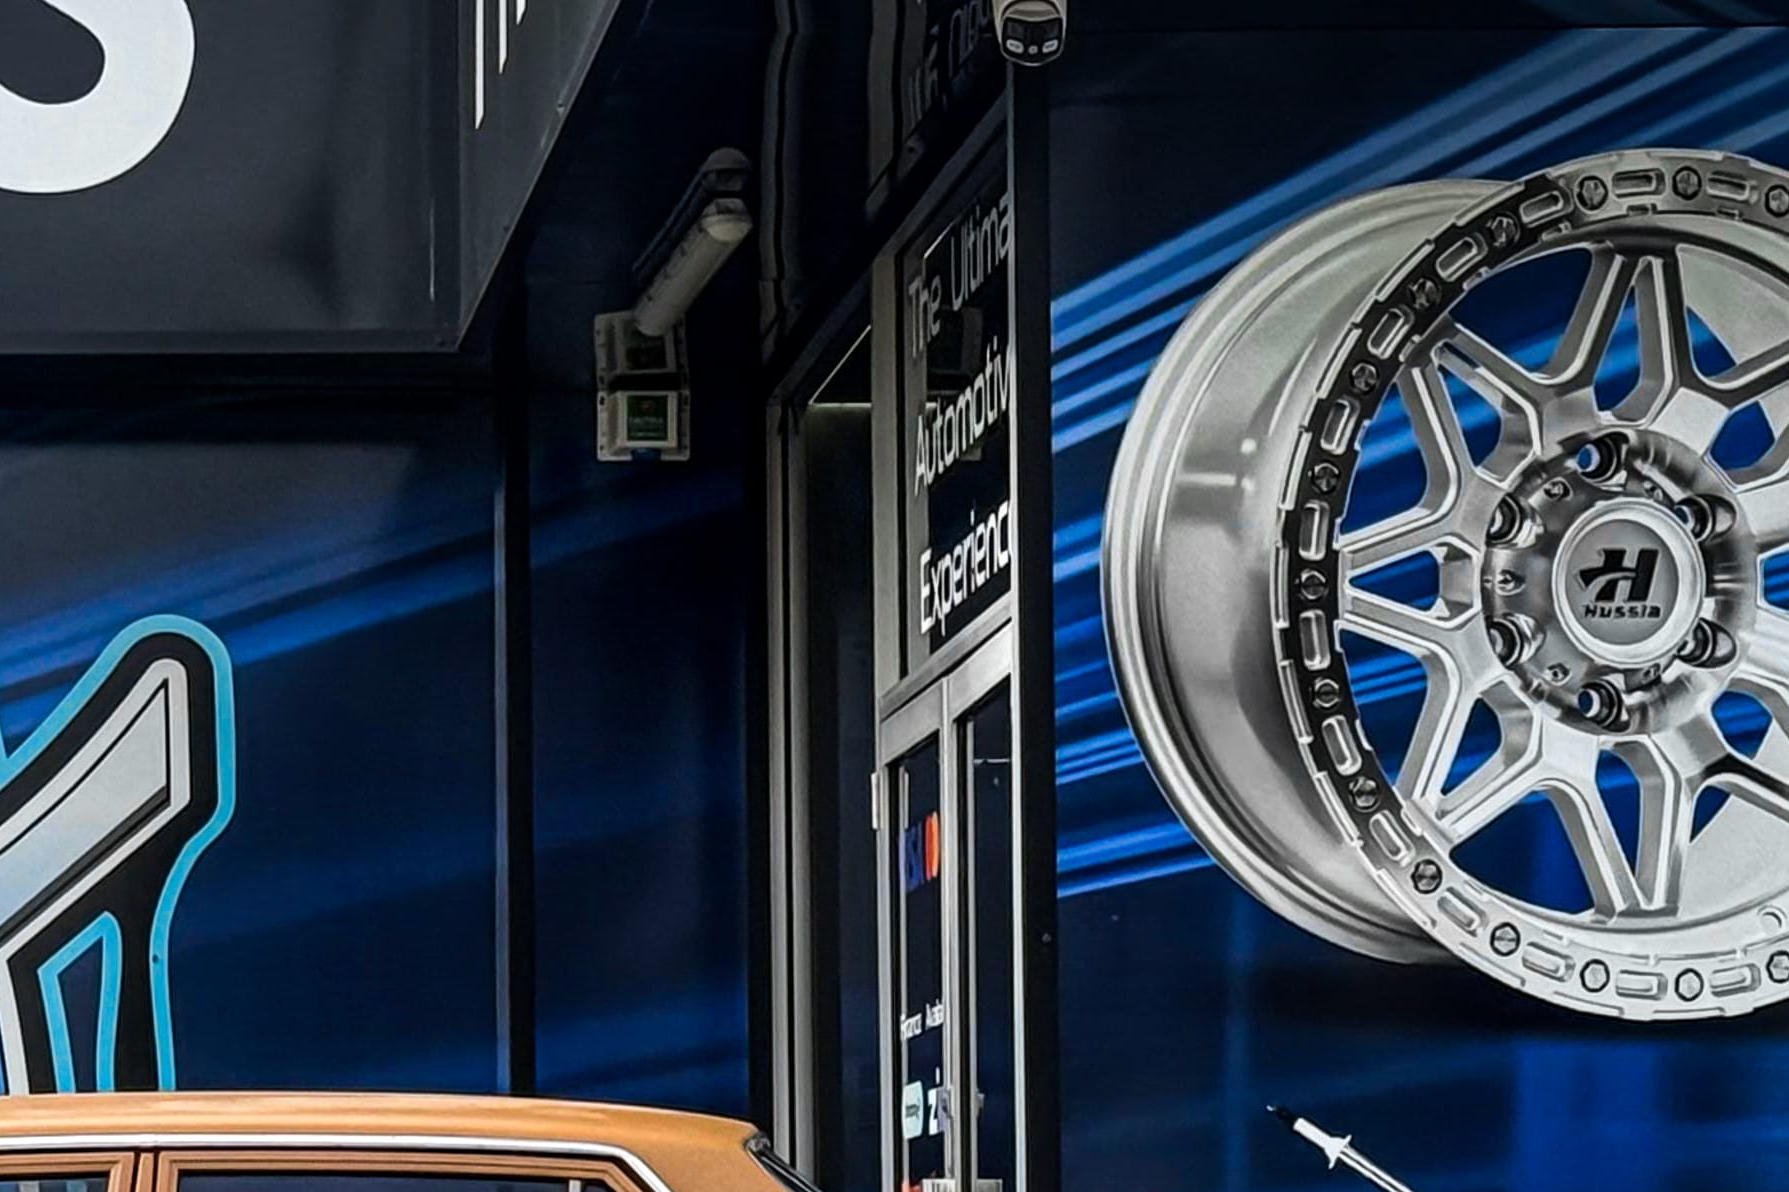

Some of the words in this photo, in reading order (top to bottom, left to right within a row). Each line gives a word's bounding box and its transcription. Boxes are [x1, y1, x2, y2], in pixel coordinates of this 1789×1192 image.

[908, 273, 942, 358] The
[950, 188, 1011, 312] Ultima
[914, 335, 1011, 497] Automotiv
[920, 500, 1011, 636] Experienc
